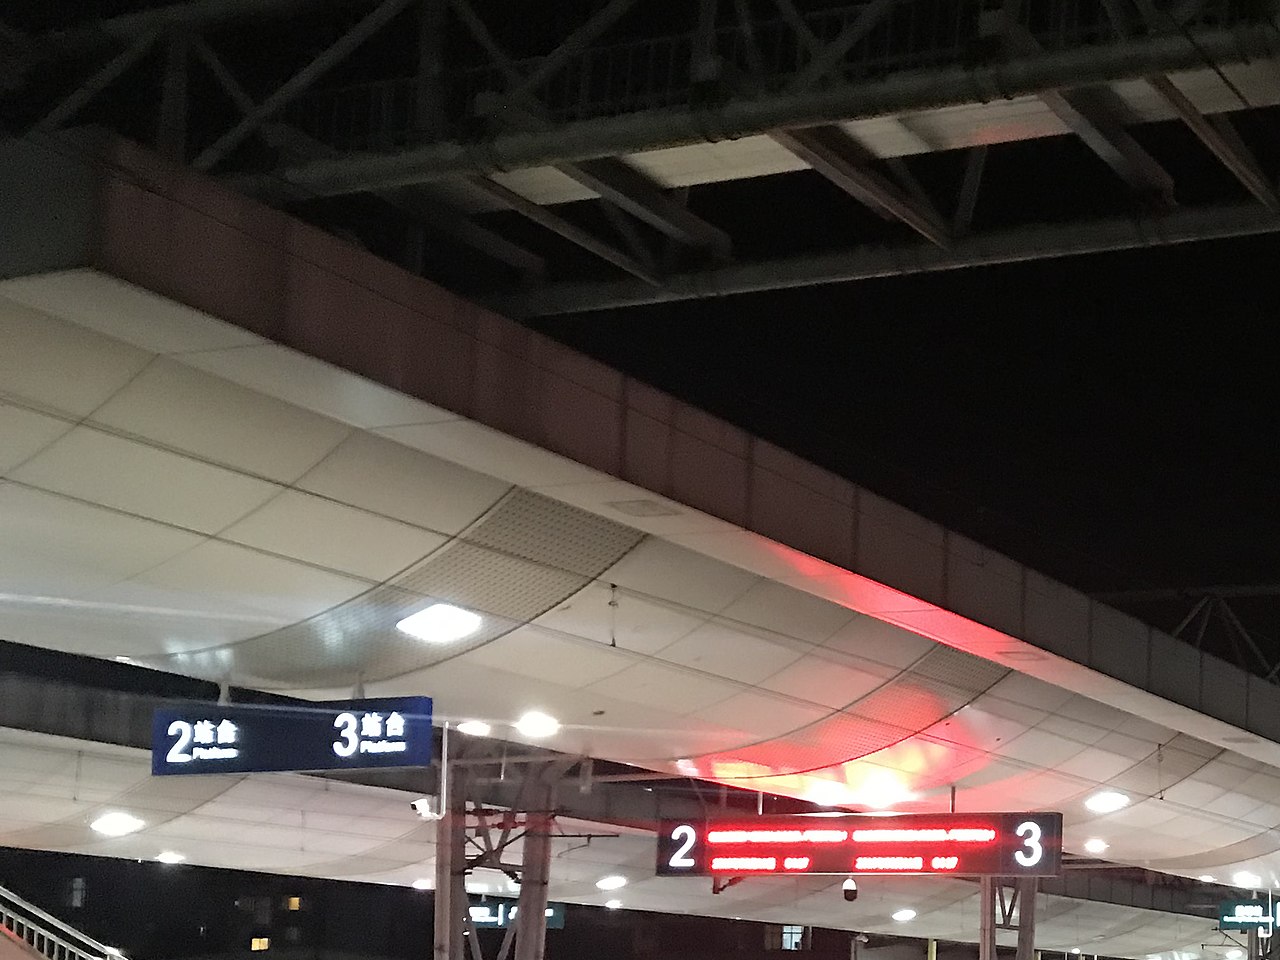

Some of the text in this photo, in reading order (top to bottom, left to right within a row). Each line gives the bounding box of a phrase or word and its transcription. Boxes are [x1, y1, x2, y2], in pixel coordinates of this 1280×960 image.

[166, 720, 192, 763] 2
[333, 711, 405, 757] 3 站台
[668, 824, 696, 868] 2
[1014, 821, 1043, 867] 3
